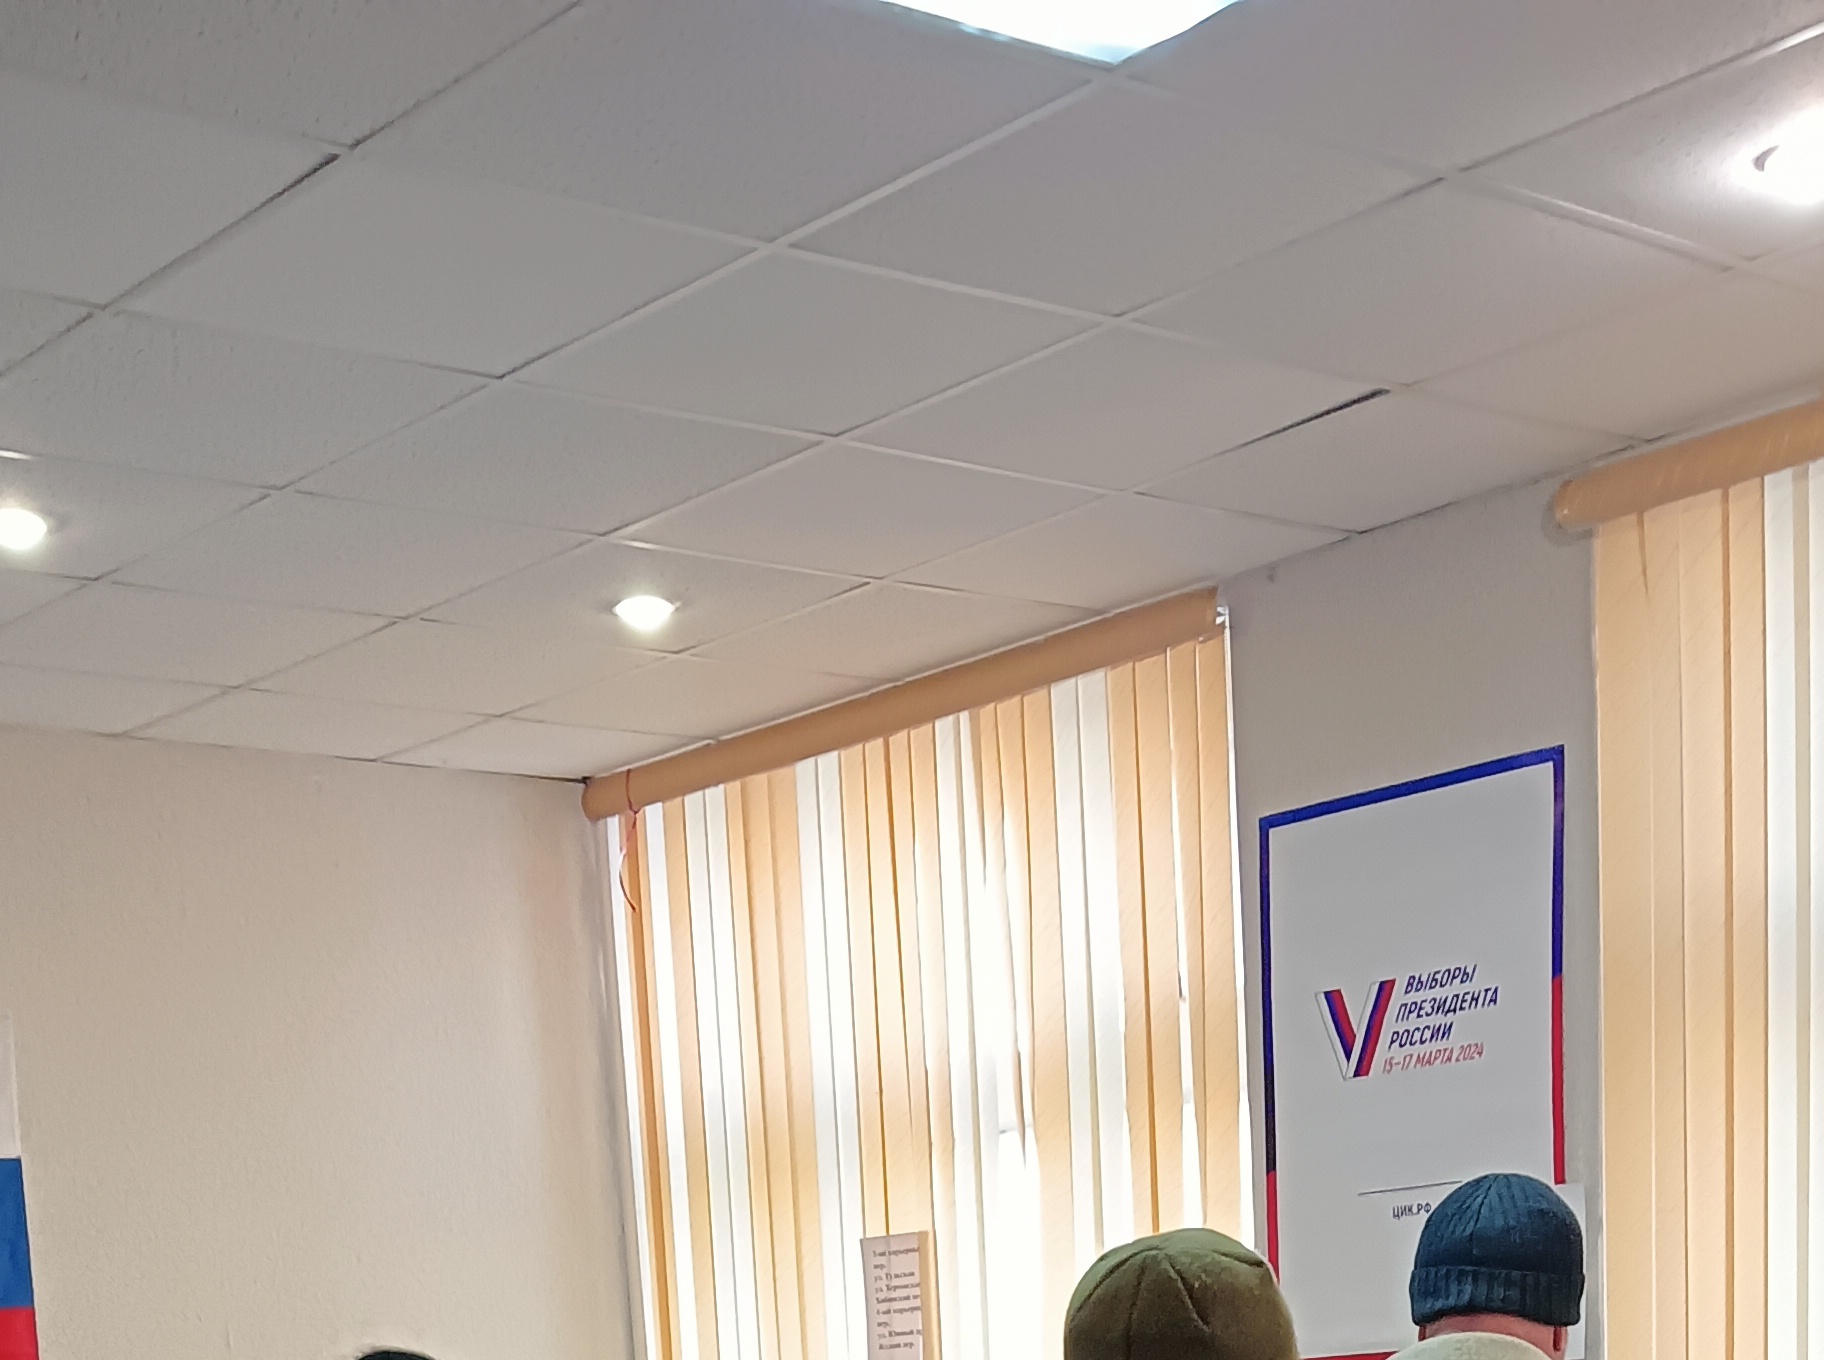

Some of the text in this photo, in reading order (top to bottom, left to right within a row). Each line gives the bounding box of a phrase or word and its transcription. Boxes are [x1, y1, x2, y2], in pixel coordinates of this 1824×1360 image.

[1404, 964, 1477, 995] ВЫБОРЫ
[1395, 986, 1499, 1023] ПРЕЗИДЕНТА
[1388, 1021, 1453, 1051] РОССИИ
[1414, 1047, 1454, 1069] МАРТА
[1455, 1042, 1485, 1063] 2024
[1392, 1203, 1432, 1220] ЦИК.РФ
